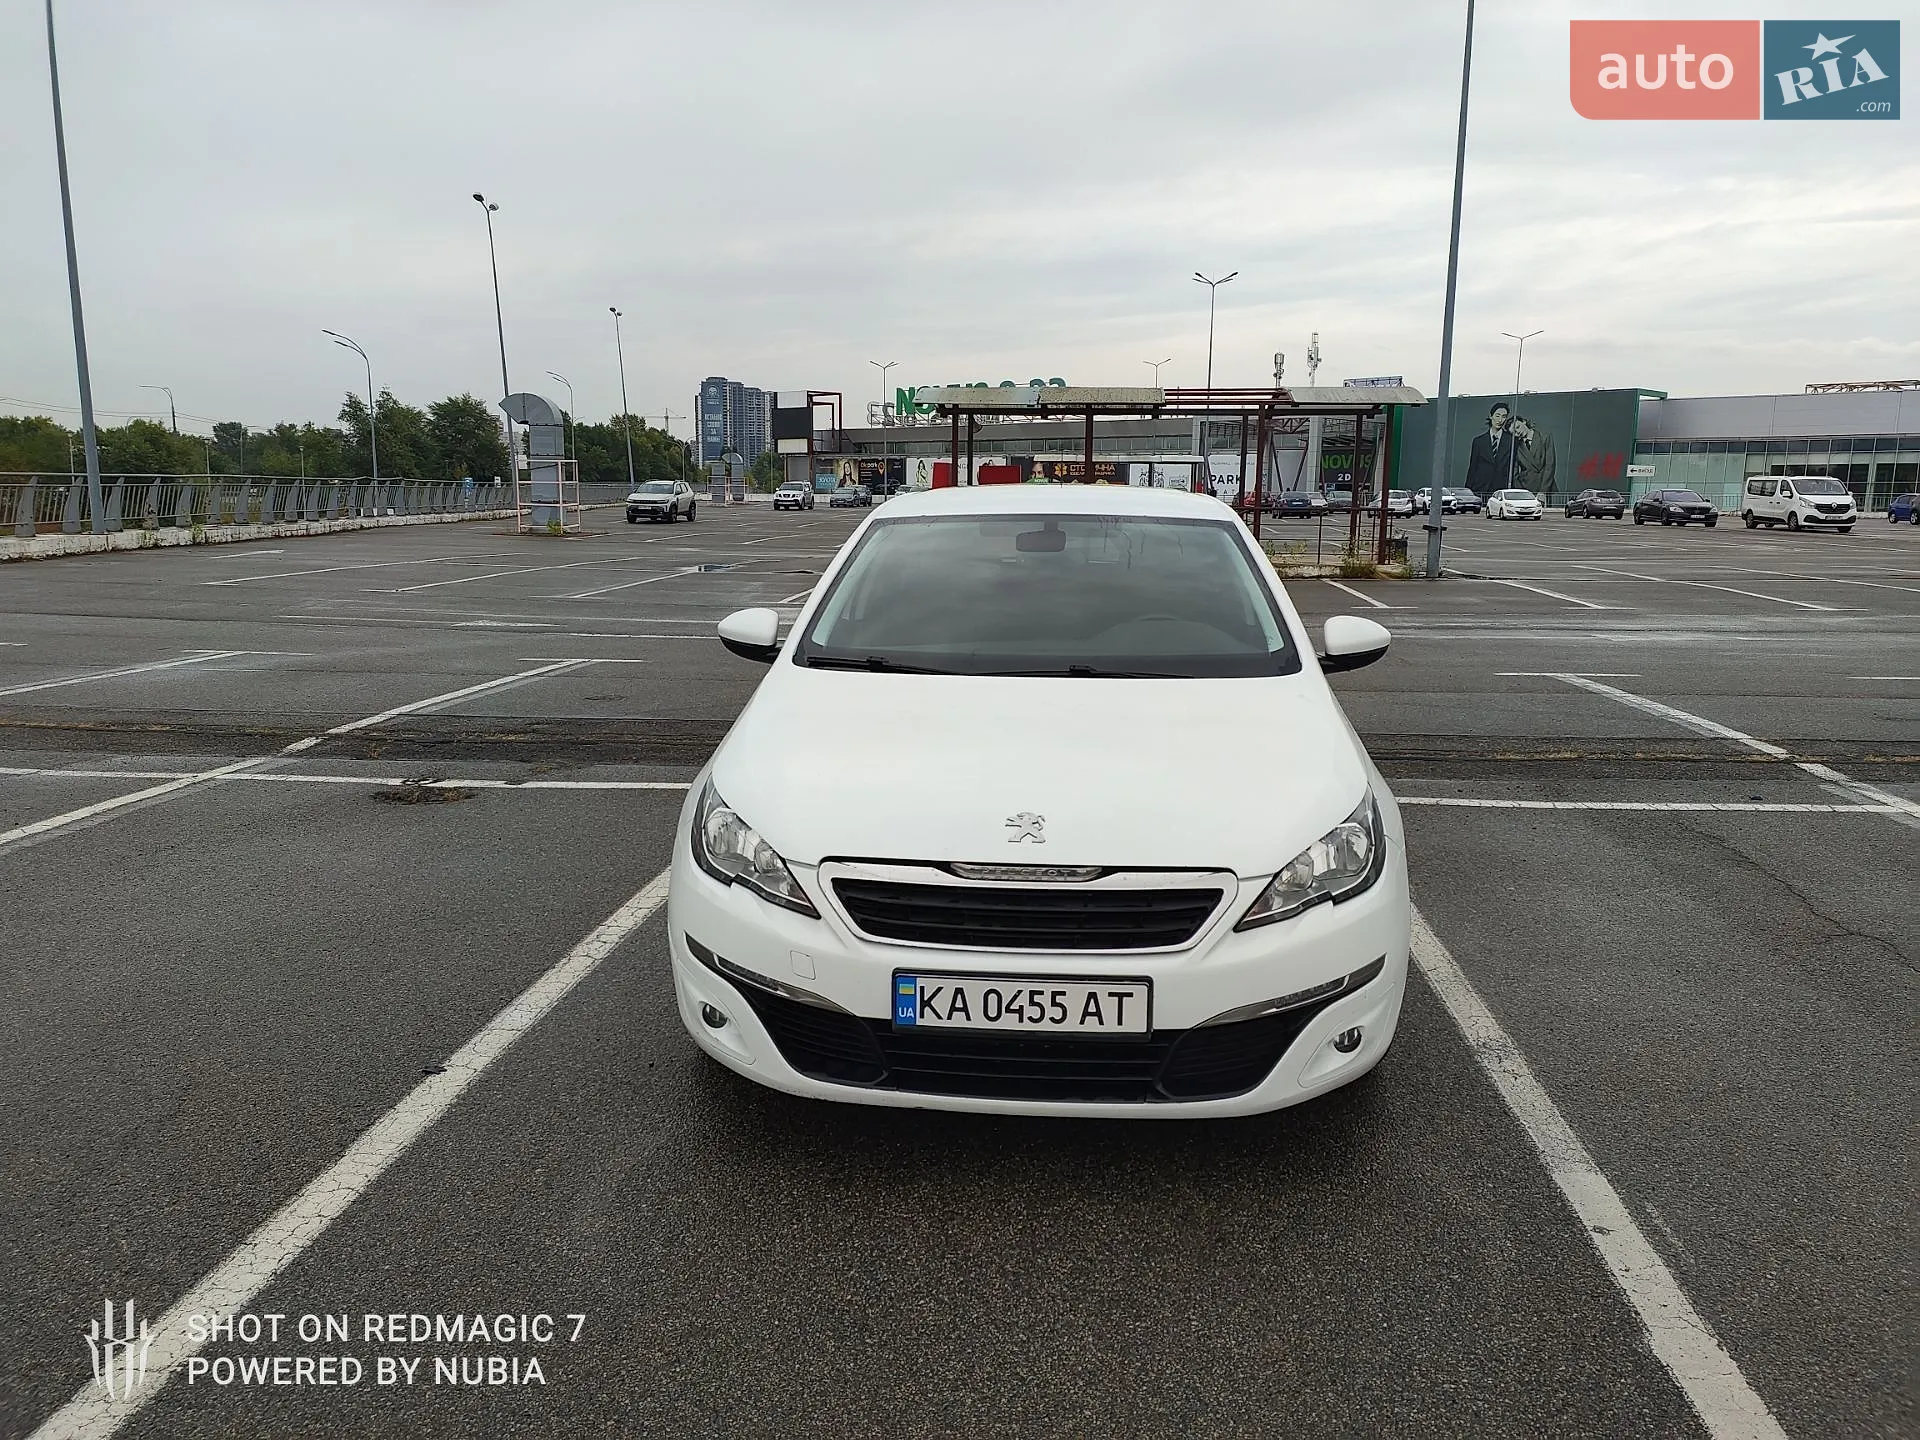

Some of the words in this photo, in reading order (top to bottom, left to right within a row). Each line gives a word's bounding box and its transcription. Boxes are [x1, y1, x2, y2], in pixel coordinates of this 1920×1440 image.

[1321, 454, 1373, 469] NOVS
[898, 1007, 915, 1018] UA
[919, 985, 972, 1022] KA
[982, 988, 1068, 1025] 0455
[1079, 991, 1134, 1027] AT
